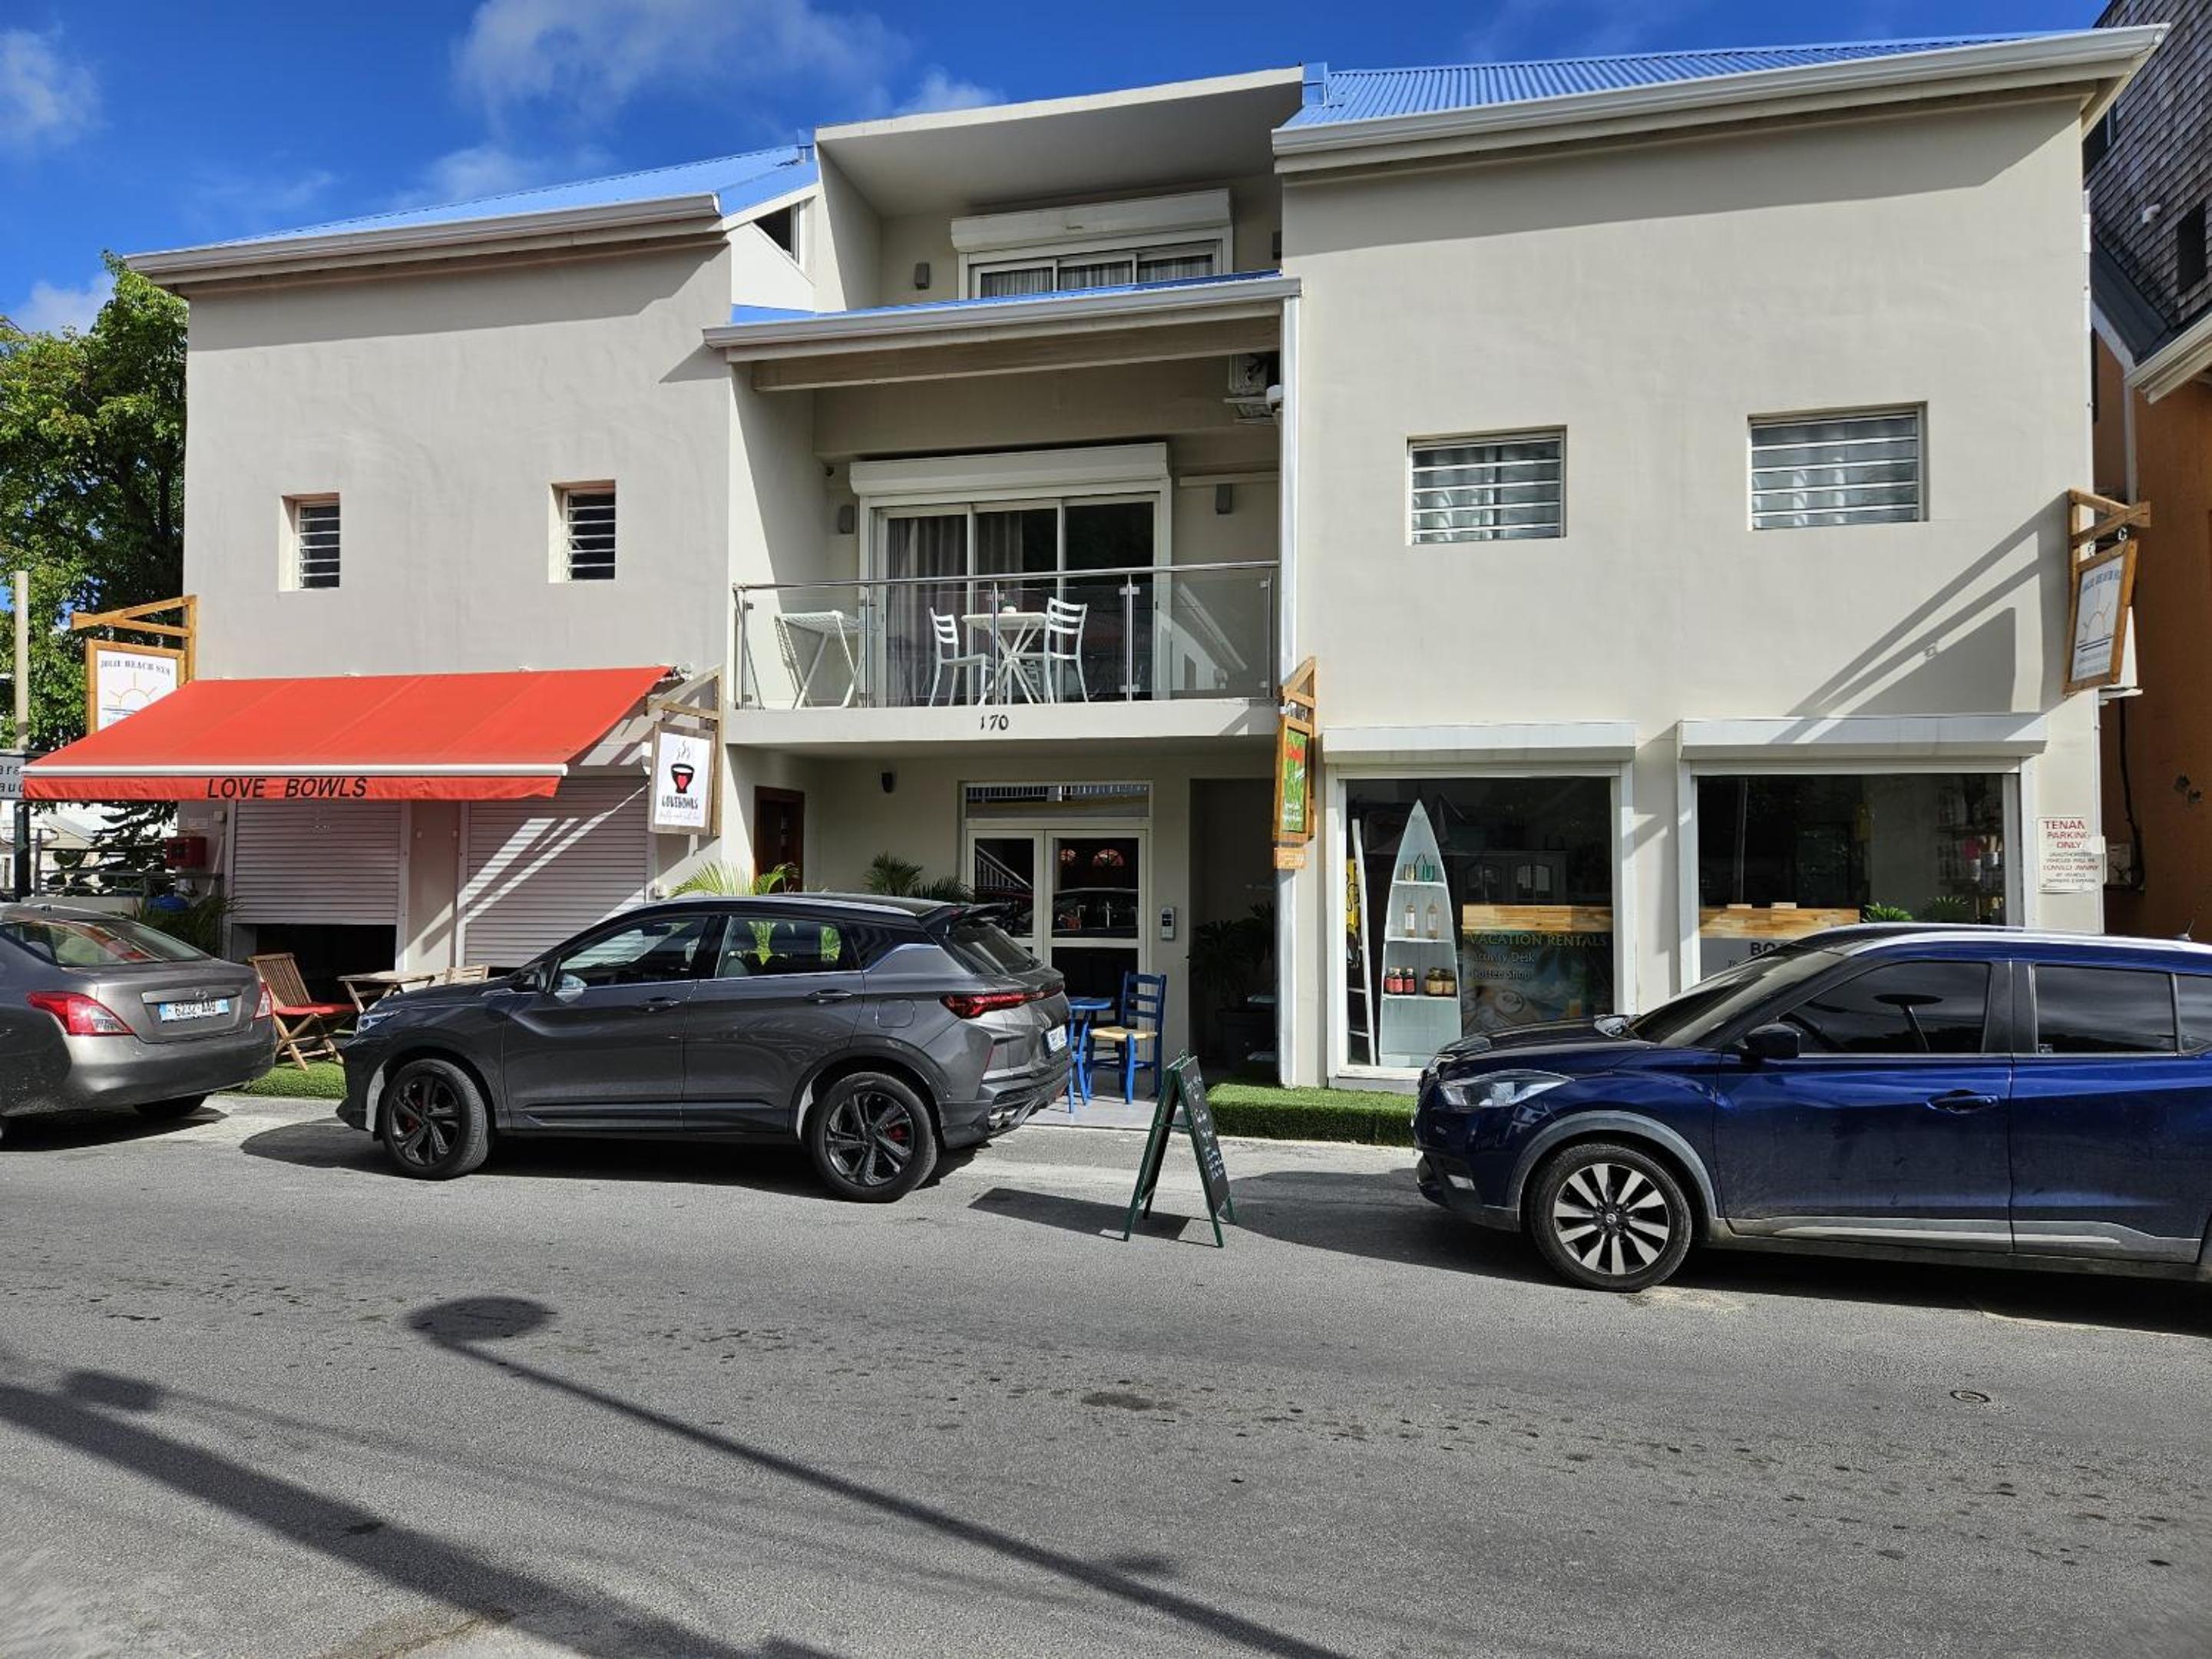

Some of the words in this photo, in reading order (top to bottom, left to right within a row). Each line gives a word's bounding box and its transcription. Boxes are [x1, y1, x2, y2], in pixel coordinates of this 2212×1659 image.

[124, 660, 154, 671] BEACH
[980, 714, 1009, 730] 170
[207, 778, 267, 798] LOVE
[284, 777, 368, 798] BOWLS
[2056, 841, 2081, 849] ONLY
[1469, 933, 1542, 947] VACATION
[1547, 934, 1608, 947] RENTALS
[1510, 951, 1535, 963] Desk
